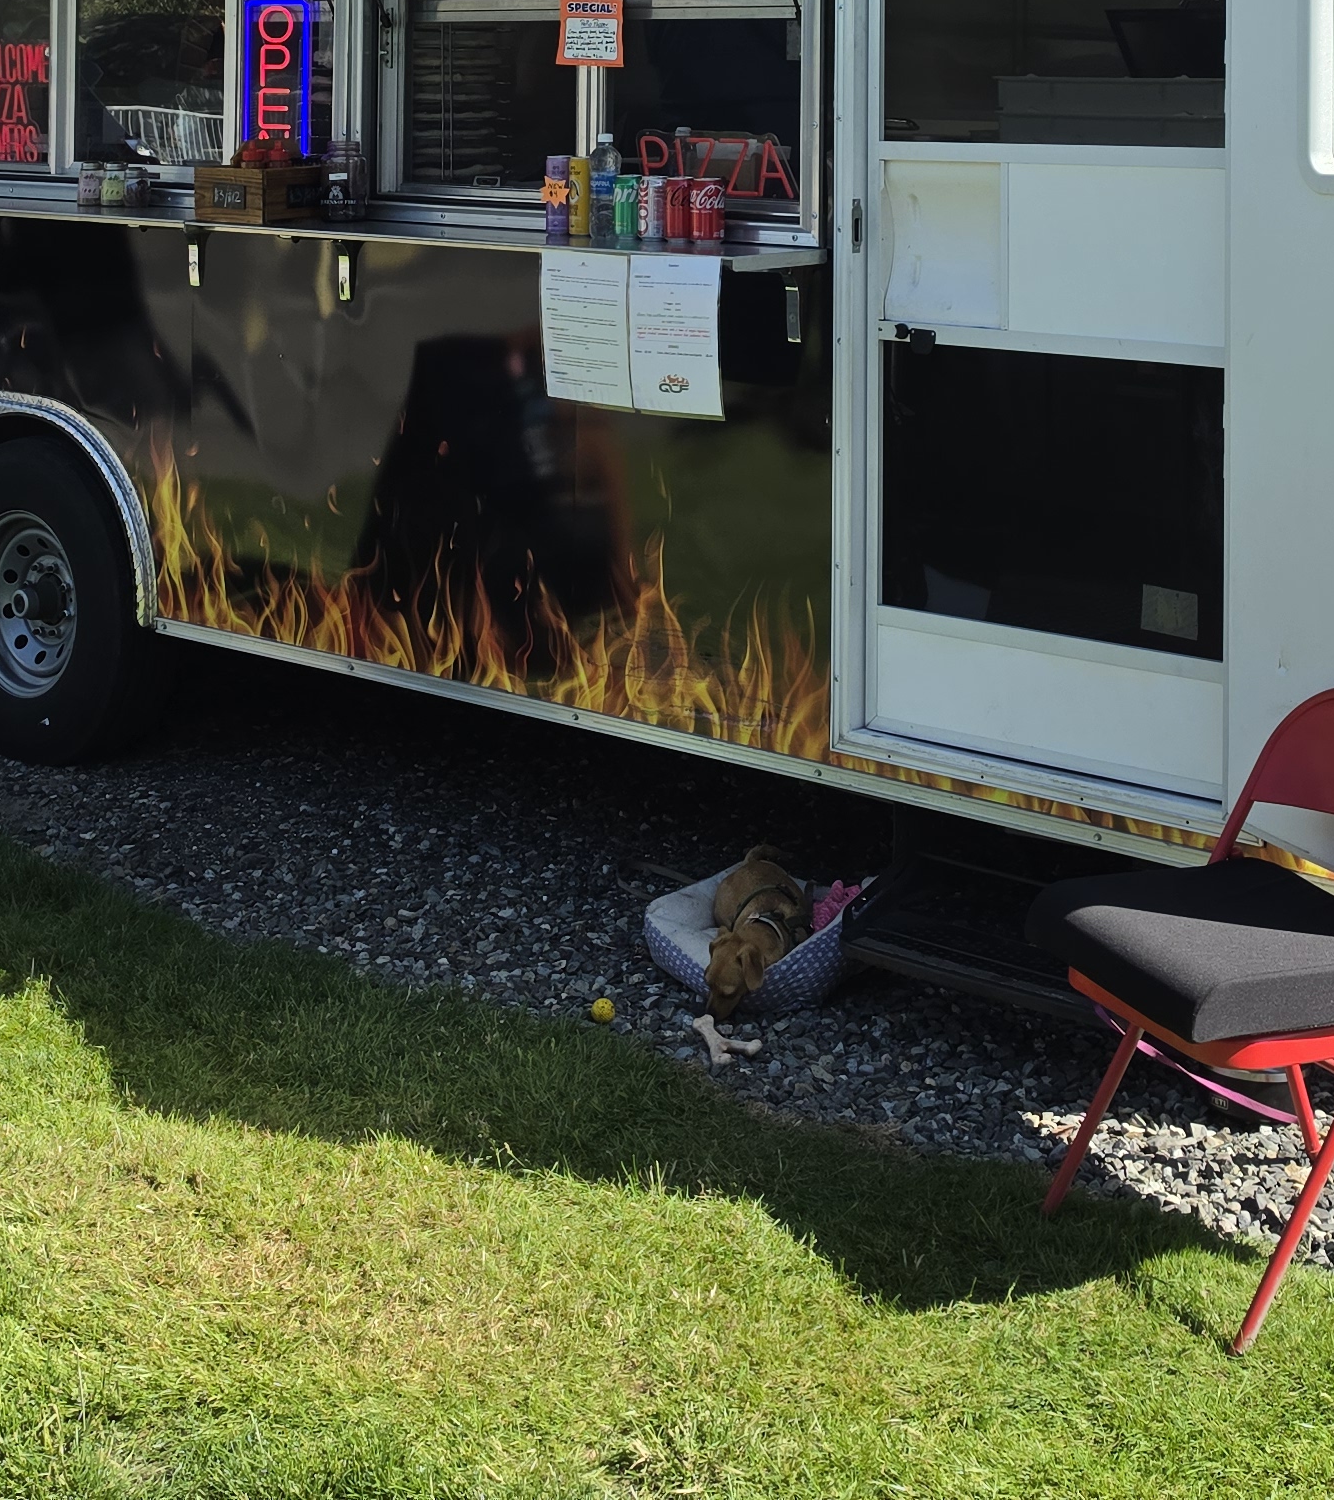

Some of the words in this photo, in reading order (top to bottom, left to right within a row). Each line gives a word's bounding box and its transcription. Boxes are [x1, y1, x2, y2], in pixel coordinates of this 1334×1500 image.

[567, 2, 617, 14] SPECIAL!
[258, 5, 294, 140] OPE
[639, 135, 795, 198] PIZZA
